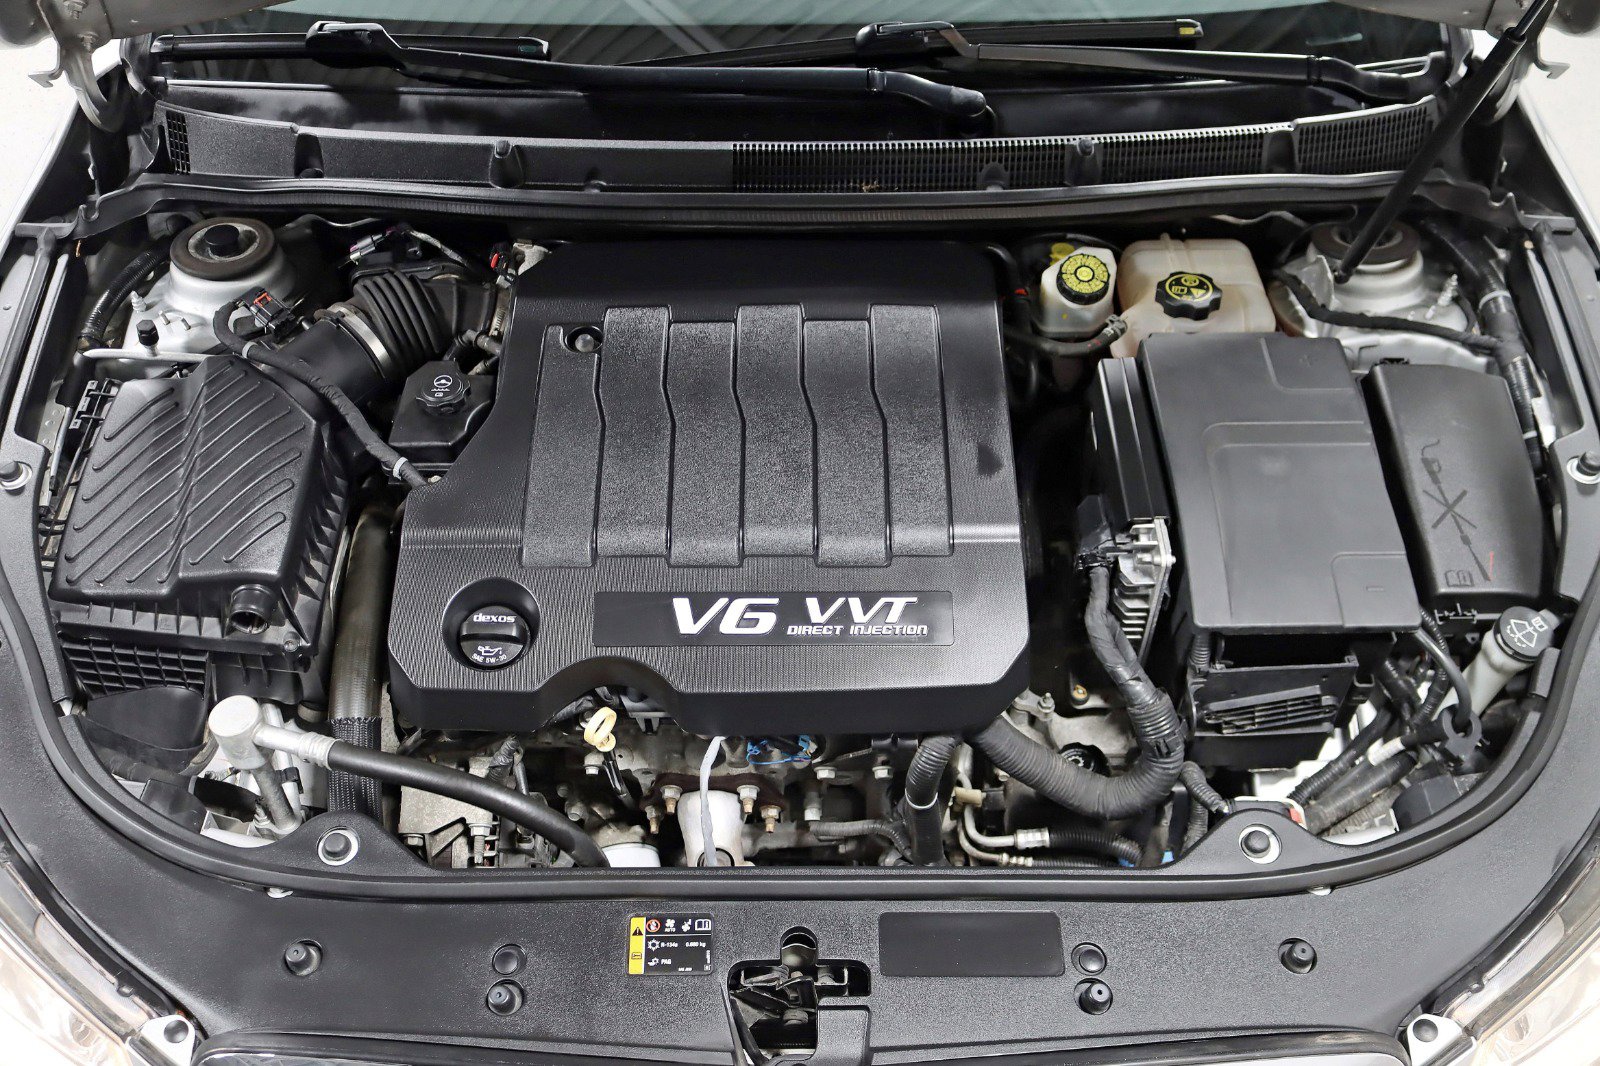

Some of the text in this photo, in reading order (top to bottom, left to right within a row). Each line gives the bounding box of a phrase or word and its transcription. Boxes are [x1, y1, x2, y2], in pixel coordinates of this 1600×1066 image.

[473, 612, 517, 623] dexos
[672, 597, 918, 635] V6 VVT
[786, 625, 928, 636] DIRECT INJECTION
[472, 653, 484, 662] SAE
